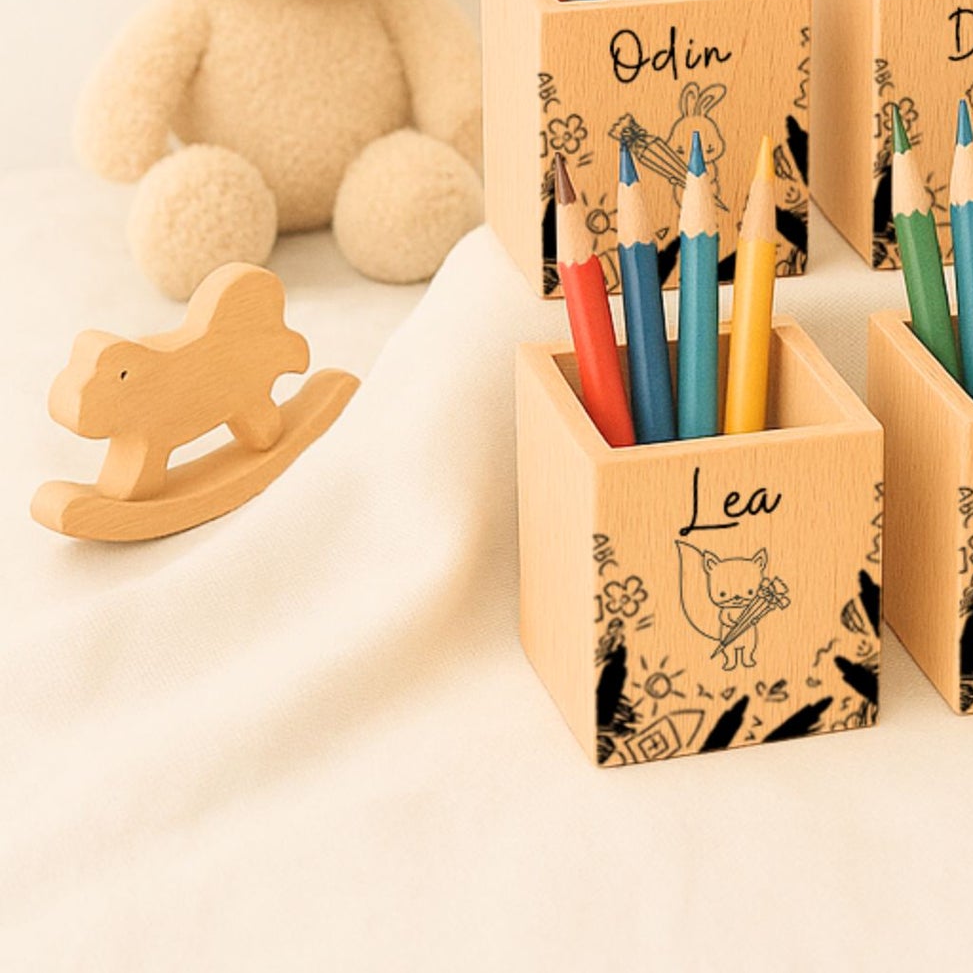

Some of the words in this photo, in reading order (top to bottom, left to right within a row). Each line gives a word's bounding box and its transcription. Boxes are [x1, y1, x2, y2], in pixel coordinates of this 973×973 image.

[610, 26, 732, 83] Odin
[537, 72, 562, 113] ABC
[874, 58, 895, 97] ABC
[679, 466, 782, 537] Lea
[592, 533, 619, 576] ABC
